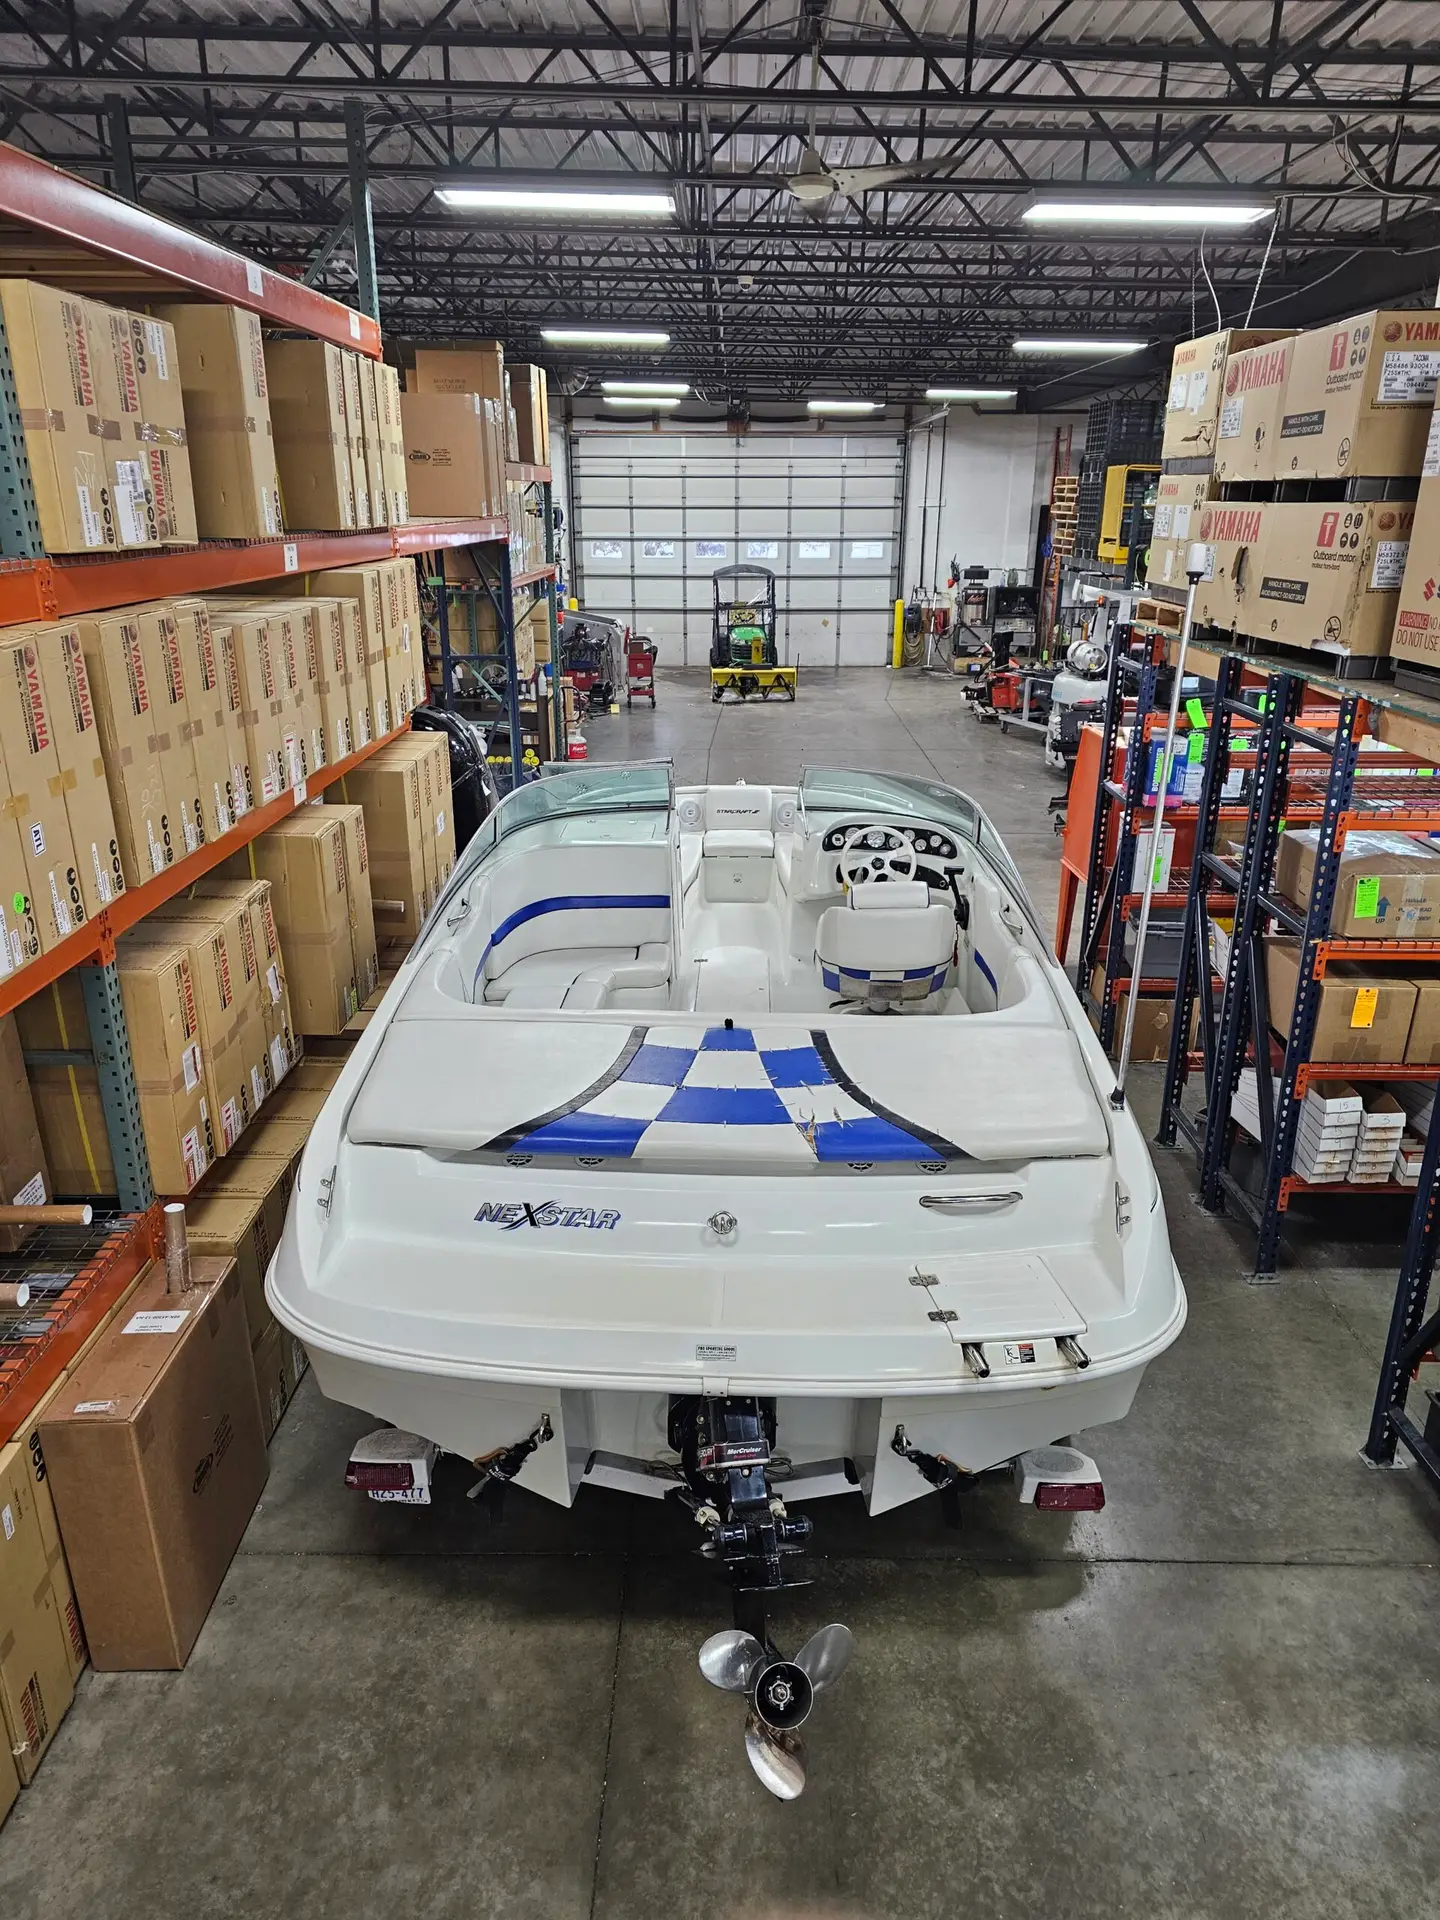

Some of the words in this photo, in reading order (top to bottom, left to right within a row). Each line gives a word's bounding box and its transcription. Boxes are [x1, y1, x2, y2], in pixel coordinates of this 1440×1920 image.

[1405, 322, 1440, 341] YAM
[75, 328, 94, 406] YAMAHA
[121, 340, 138, 413] YAMAHA
[255, 338, 266, 398] YAMAHA
[1240, 349, 1287, 392] YAMAHA
[1326, 372, 1348, 386] Outboard
[1348, 369, 1364, 381] motor
[1287, 416, 1301, 425] HANDLE
[1301, 415, 1310, 424] WITH
[1310, 413, 1320, 422] CARE
[151, 449, 167, 517] YAMAHA
[1213, 510, 1262, 543] YAMAHA
[1313, 550, 1337, 562] Outboard
[1337, 552, 1356, 563] motor
[1267, 580, 1282, 588] HANDLE
[1282, 581, 1291, 589] WITH
[1291, 583, 1302, 591] CARE
[201, 626, 216, 690] YAMAHA
[286, 634, 298, 688] YAMAHA
[306, 628, 317, 679] YAMAHA
[333, 622, 343, 671] YAMAHA
[1396, 629, 1408, 645] DO
[1408, 631, 1424, 648] NOT
[1424, 633, 1440, 652] USE
[73, 654, 93, 729] YAMAHA
[131, 643, 149, 713] YAMAHA
[168, 635, 185, 702] YAMAHA
[228, 650, 241, 711] YAMAHA
[263, 642, 275, 698] YAMAHA
[19, 691, 34, 755] Accessories
[27, 668, 50, 751] YAMAHA
[66, 674, 80, 734] Accessories
[33, 828, 42, 851] ATL
[245, 924, 256, 979] YAMAHA
[265, 902, 276, 954] YAMAHA
[183, 975, 197, 1035] YAMAHA
[220, 950, 233, 1006] YAMAHA
[474, 1199, 622, 1232] NEXSTAR
[727, 1447, 762, 1455] MerCruiser
[64, 1599, 82, 1651] YAMAHA
[20, 1685, 38, 1742] YAMAHA
